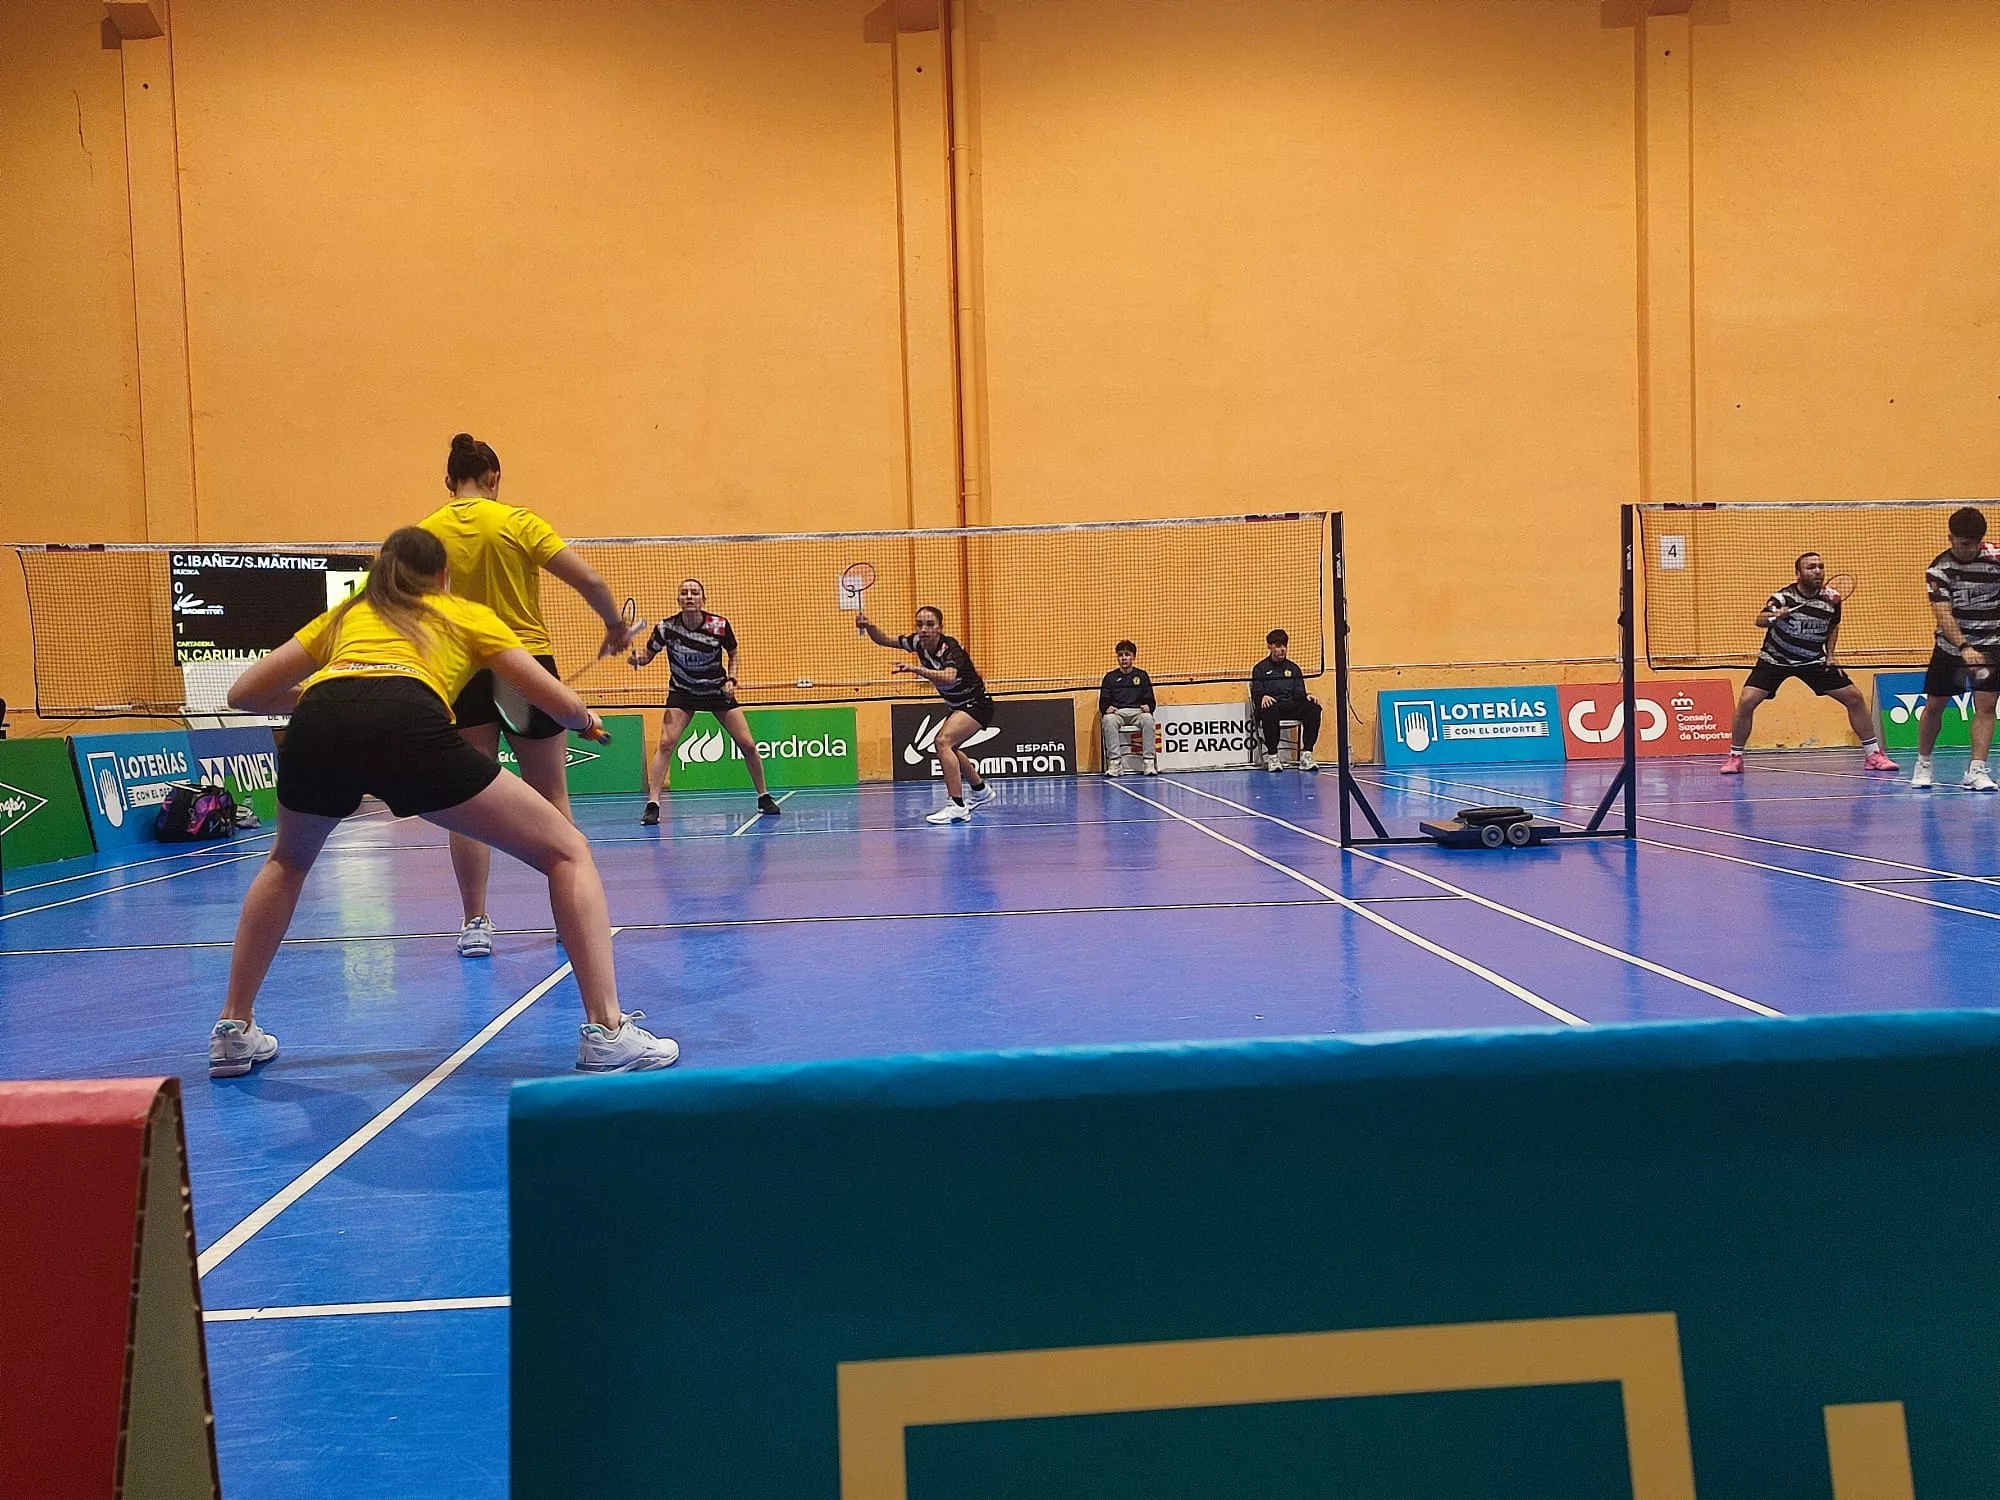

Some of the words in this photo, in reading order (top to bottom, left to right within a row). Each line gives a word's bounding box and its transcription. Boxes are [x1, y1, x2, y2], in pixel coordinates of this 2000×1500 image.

[1667, 544, 1678, 558] 4
[174, 581, 184, 594] 0
[847, 585, 856, 598] 3
[176, 622, 184, 634] 1
[1440, 699, 1547, 721] LOTERÍAS
[1676, 713, 1713, 724] Consejo
[1455, 727, 1476, 735] CON
[1479, 727, 1490, 735] EL
[1493, 725, 1537, 734] DEPORTE
[1678, 723, 1717, 732] Superior
[1680, 732, 1692, 740] de
[1016, 742, 1065, 753] ESPAÑA
[1165, 739, 1189, 753] DE
[1194, 737, 1263, 752] ARAGO
[120, 747, 188, 780] LOTERÍAS
[226, 752, 278, 793] YONEX
[136, 791, 150, 801] CON
[151, 789, 159, 799] EL
[0, 795, 26, 818] nglés
